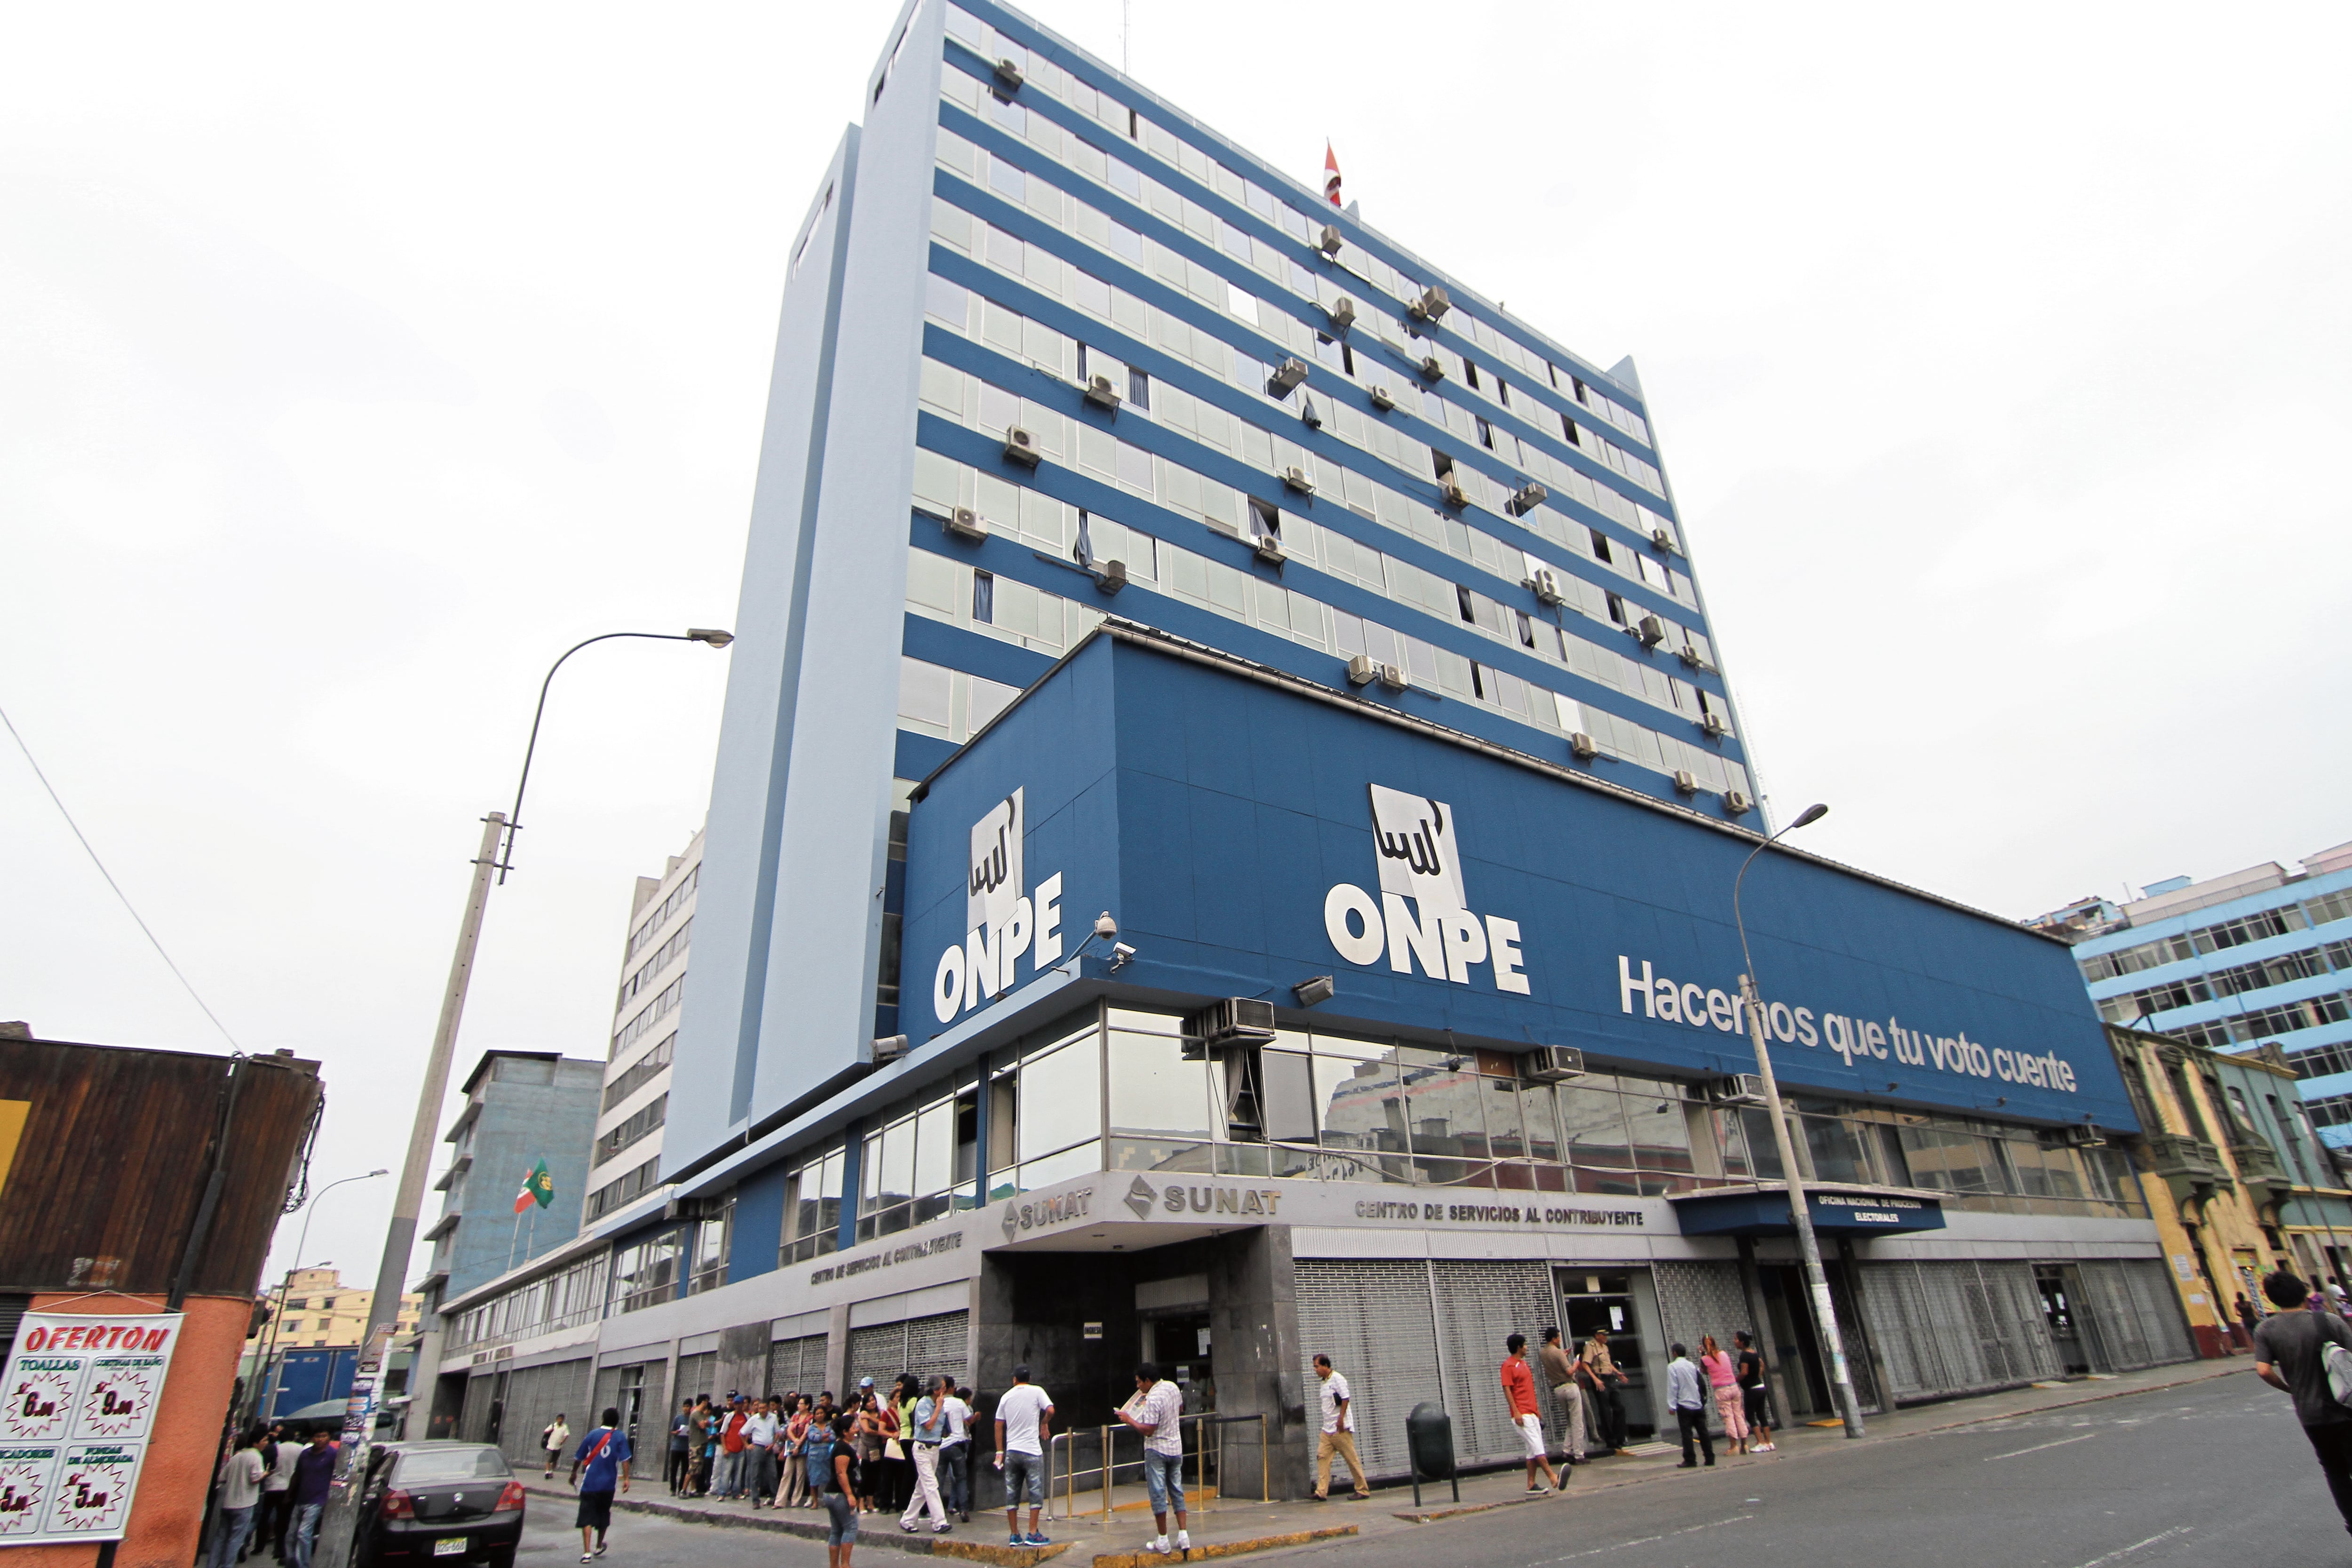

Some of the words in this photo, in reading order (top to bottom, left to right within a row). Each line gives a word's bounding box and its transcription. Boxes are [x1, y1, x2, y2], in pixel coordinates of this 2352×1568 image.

[934, 870, 1062, 1023] ONPE
[1324, 883, 1531, 995] ONPE
[1823, 1013, 1888, 1067] que
[1889, 1016, 1925, 1066] tu
[1924, 1031, 1992, 1078] voto
[1993, 1050, 2077, 1093] cuente
[1020, 1187, 1092, 1229] SUNAT
[1164, 1186, 1281, 1215] SUNAT
[1355, 1201, 1418, 1219] CENTRO
[1423, 1203, 1444, 1220] DE
[1449, 1205, 1520, 1222] SERVICIOS
[1525, 1208, 1542, 1223] AL
[1546, 1209, 1644, 1226] CONTRIBUYENTE
[1818, 1195, 1847, 1205] OFICINA
[1846, 1197, 1879, 1207] NACIONAL
[1882, 1199, 1890, 1208] DE
[1890, 1200, 1922, 1209] PROCESOS
[1854, 1212, 1899, 1222] ELECTORALES
[811, 1268, 834, 1285] CENTRO
[835, 1264, 845, 1279] DE
[847, 1255, 881, 1276] SERVICIOS
[882, 1251, 892, 1266] AL
[894, 1231, 962, 1264] CONTRIBUYENTE
[26, 1326, 170, 1352] OFERTON
[20, 1360, 80, 1370] TOALLAS
